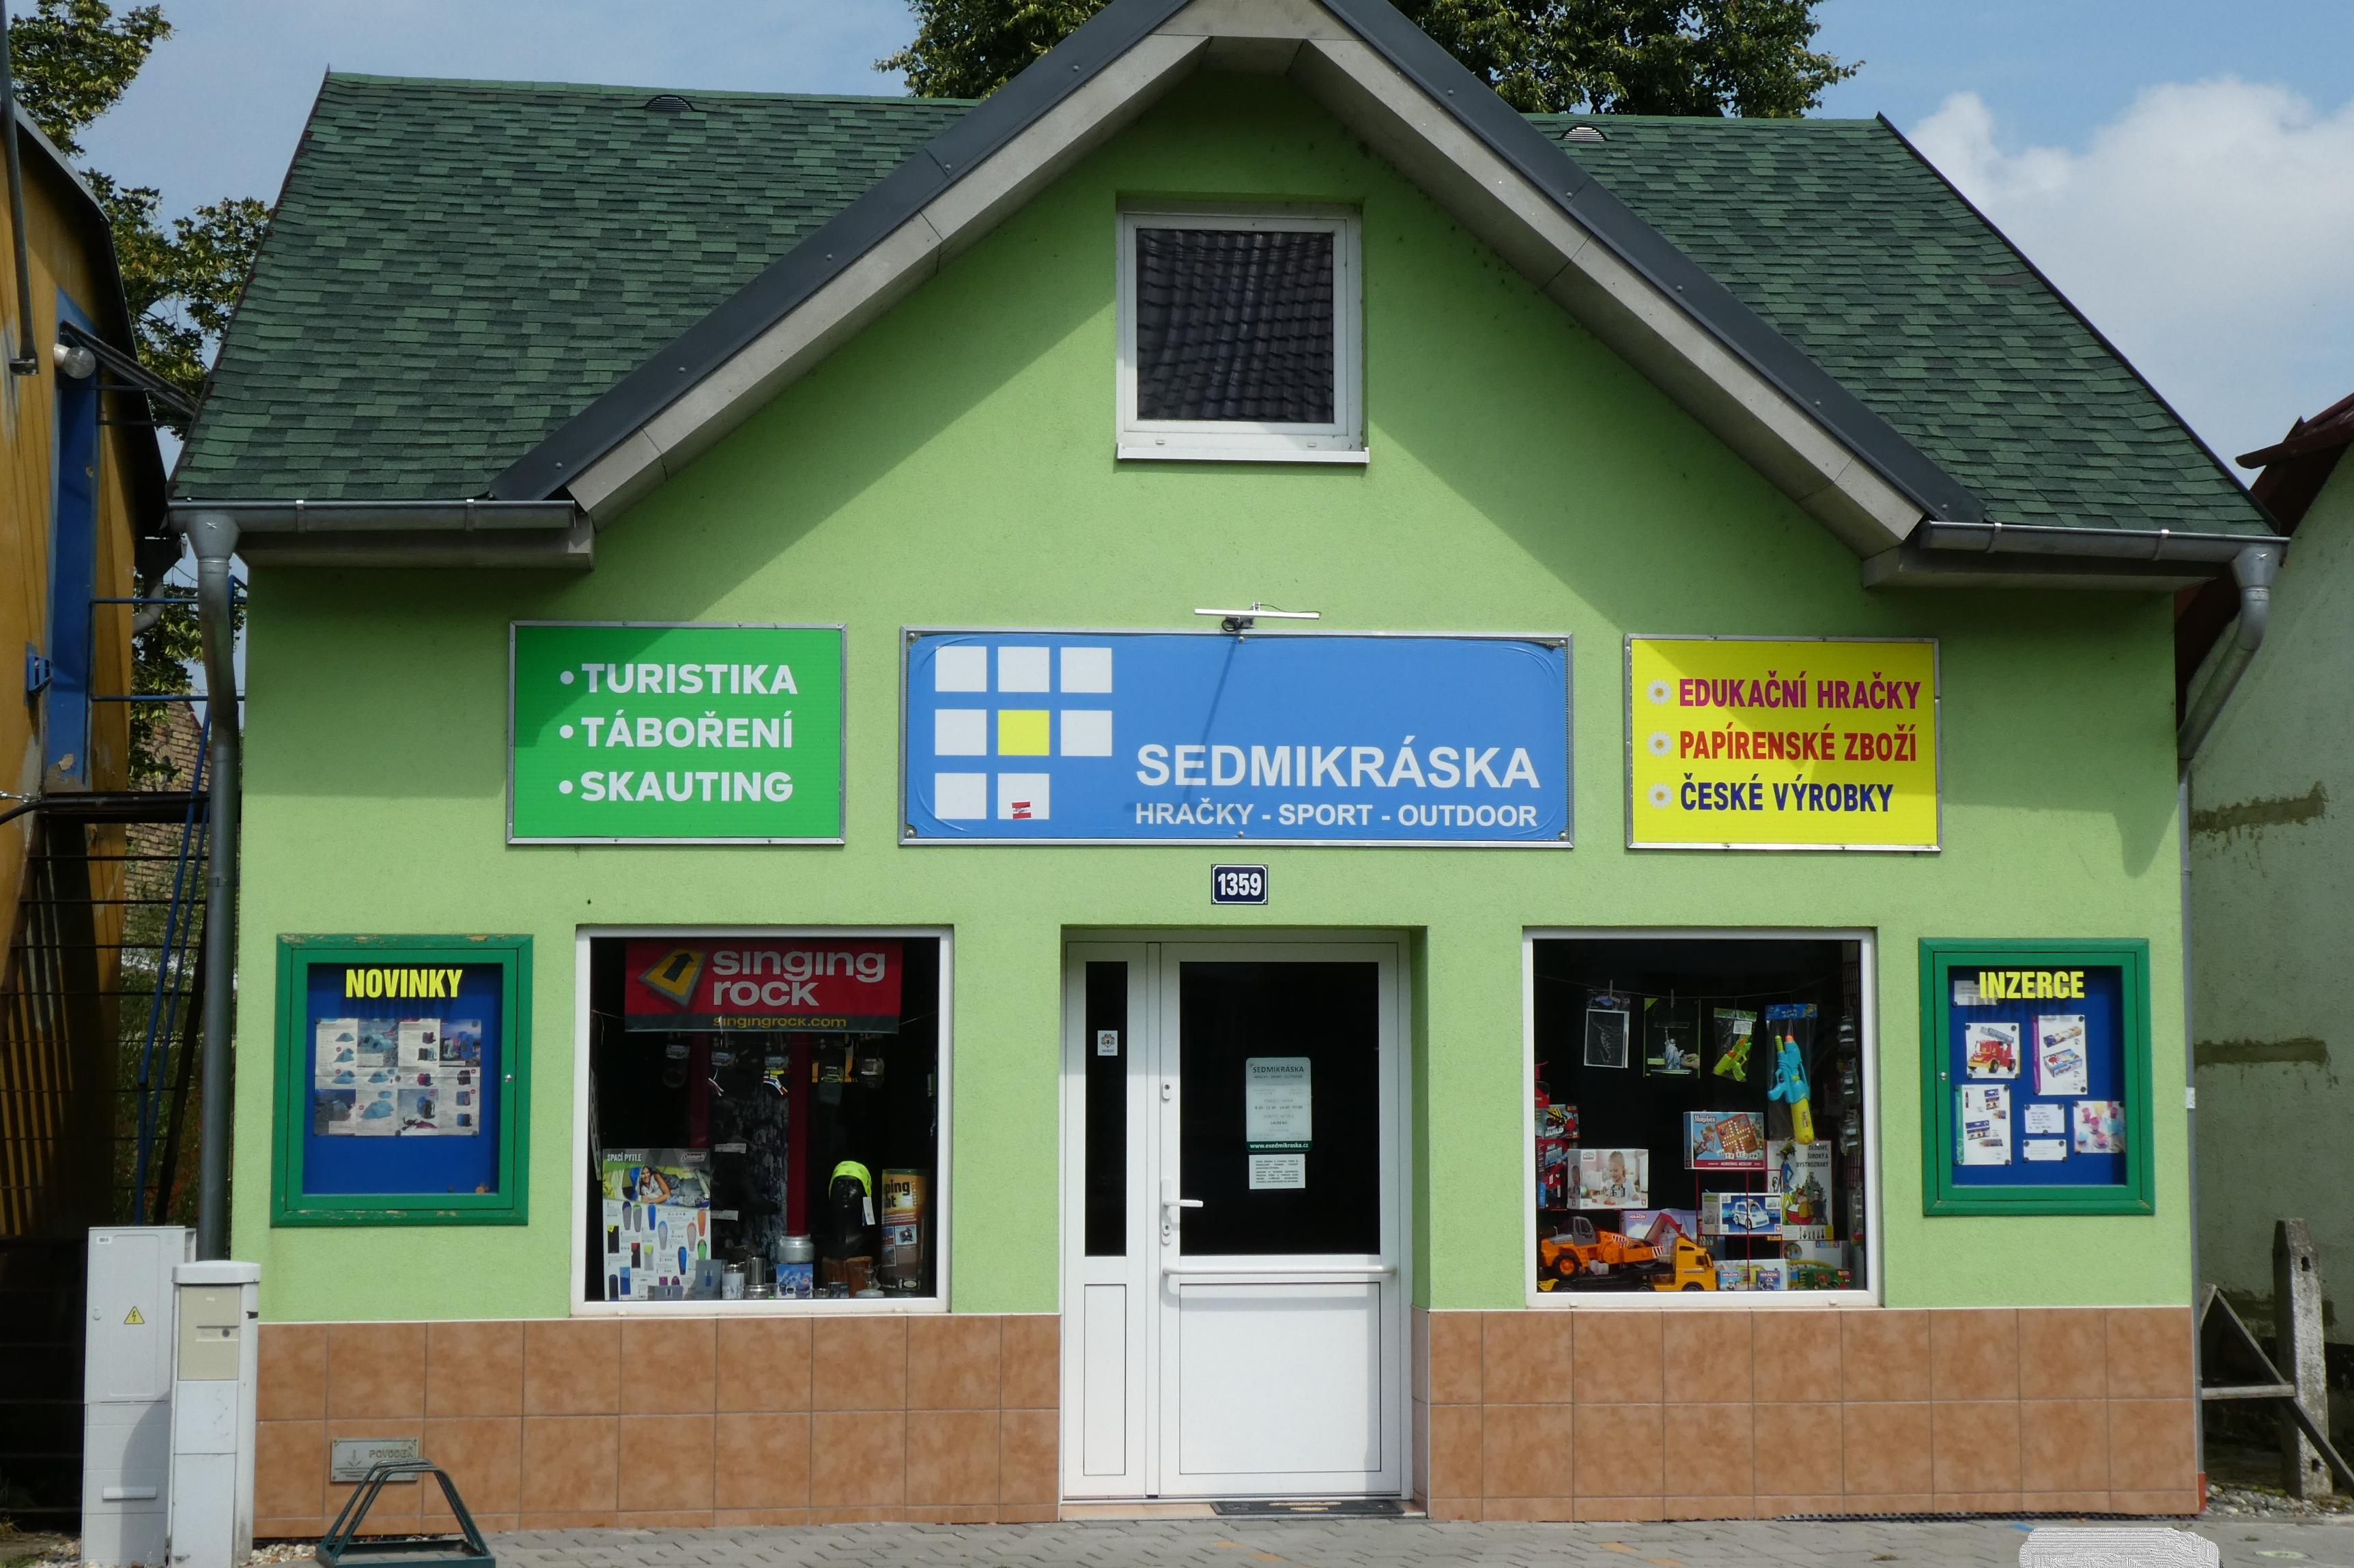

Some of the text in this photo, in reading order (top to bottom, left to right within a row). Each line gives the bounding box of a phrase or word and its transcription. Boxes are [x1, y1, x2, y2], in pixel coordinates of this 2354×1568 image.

[581, 662, 798, 695] TURISTIKA
[1679, 670, 1921, 709] EDUKAČNÍ HRAČKY
[581, 709, 793, 748] TÁBOŘENÍ
[1679, 722, 1916, 762] PAPÍRENSKÉ ZBOŽÍ
[1136, 735, 1540, 789] SEDMIKRÁSKA
[580, 771, 794, 803] SKAUTING
[1681, 772, 1894, 812] ČESKÉ VÝROBKY
[1136, 797, 1253, 825] HRAČKY
[1278, 803, 1373, 827] SPORT
[1398, 805, 1538, 827] OUTDOOR
[1217, 872, 1262, 897] 1359
[712, 950, 885, 983] singing
[345, 968, 464, 999] NOVINKY
[713, 978, 820, 1007] rock
[1979, 971, 2085, 999] INZERCE
[712, 1016, 847, 1029] singingrock.com
